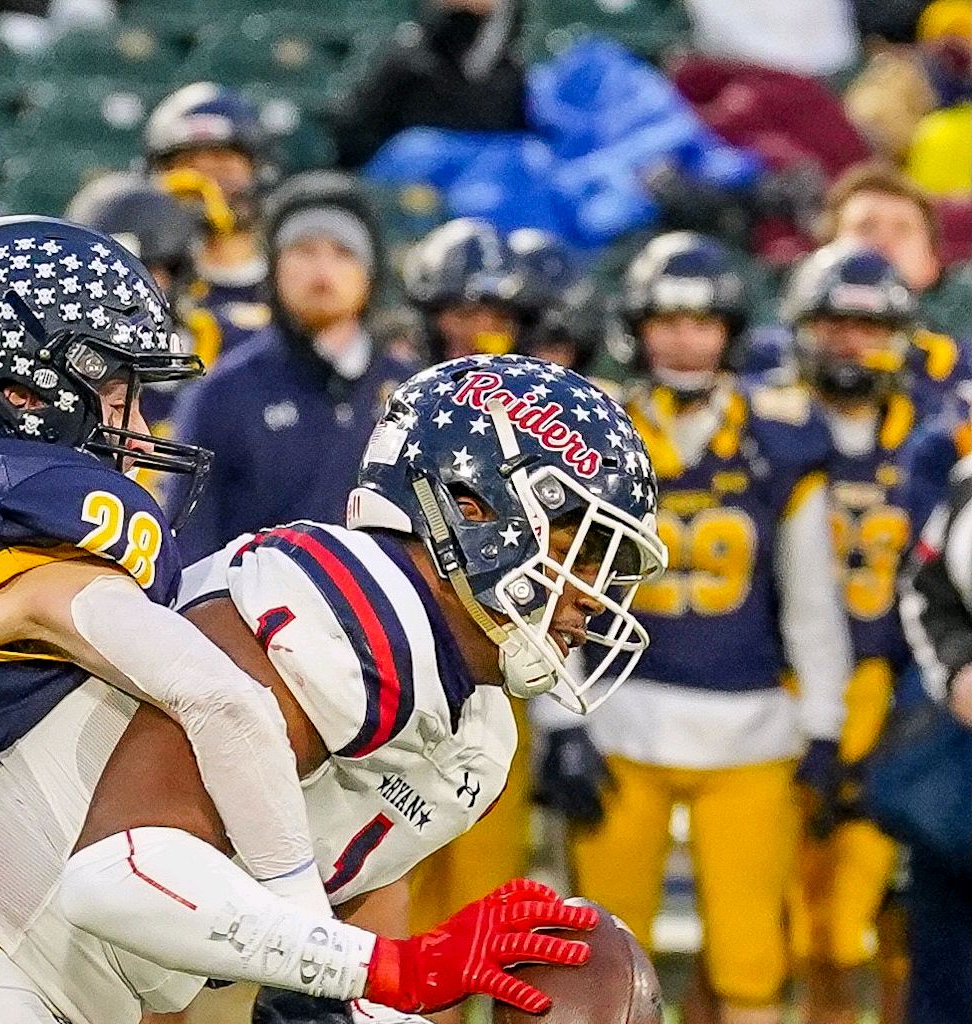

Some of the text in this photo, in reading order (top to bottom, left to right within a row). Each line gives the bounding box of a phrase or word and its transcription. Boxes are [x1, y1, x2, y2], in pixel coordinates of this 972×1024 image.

[451, 370, 604, 480] Raiders
[75, 490, 163, 590] 28
[381, 773, 427, 823] RYAN
[323, 811, 395, 895] 1
